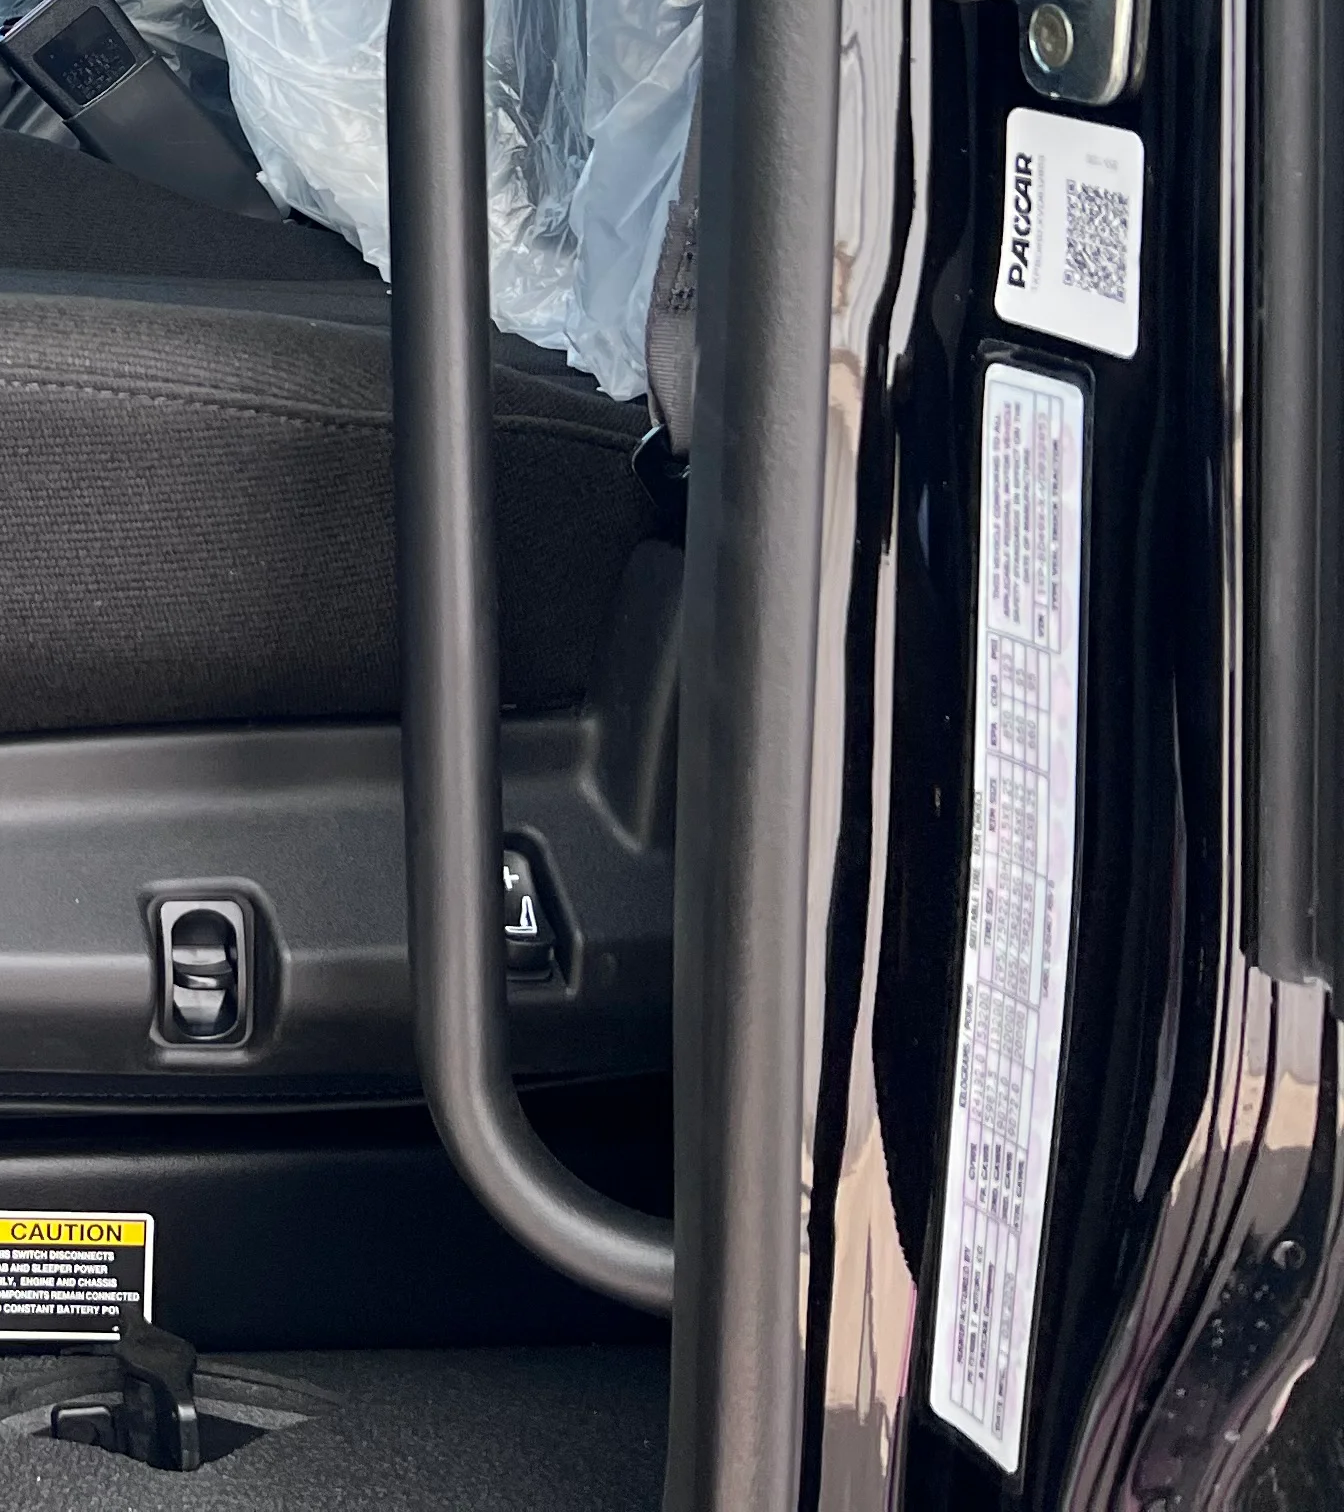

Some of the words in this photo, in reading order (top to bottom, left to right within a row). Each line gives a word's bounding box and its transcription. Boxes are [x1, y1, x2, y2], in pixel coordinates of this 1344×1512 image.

[1006, 153, 1032, 288] PACCAR
[11, 1223, 122, 1242] CAUTION
[12, 1250, 48, 1260] SWITCH
[49, 1251, 115, 1261] DISCONNECTS
[10, 1264, 30, 1273] AND
[32, 1264, 72, 1274] SLEEPER
[74, 1265, 108, 1274] POWER
[20, 1277, 55, 1287] ENGINE
[56, 1278, 76, 1287] AND
[78, 1278, 117, 1288] CHASSIS
[51, 1292, 85, 1301] REMAIN
[86, 1292, 140, 1302] CONNECTED
[3, 1304, 54, 1314] CONSTANT
[56, 1305, 100, 1315] BATTERY
